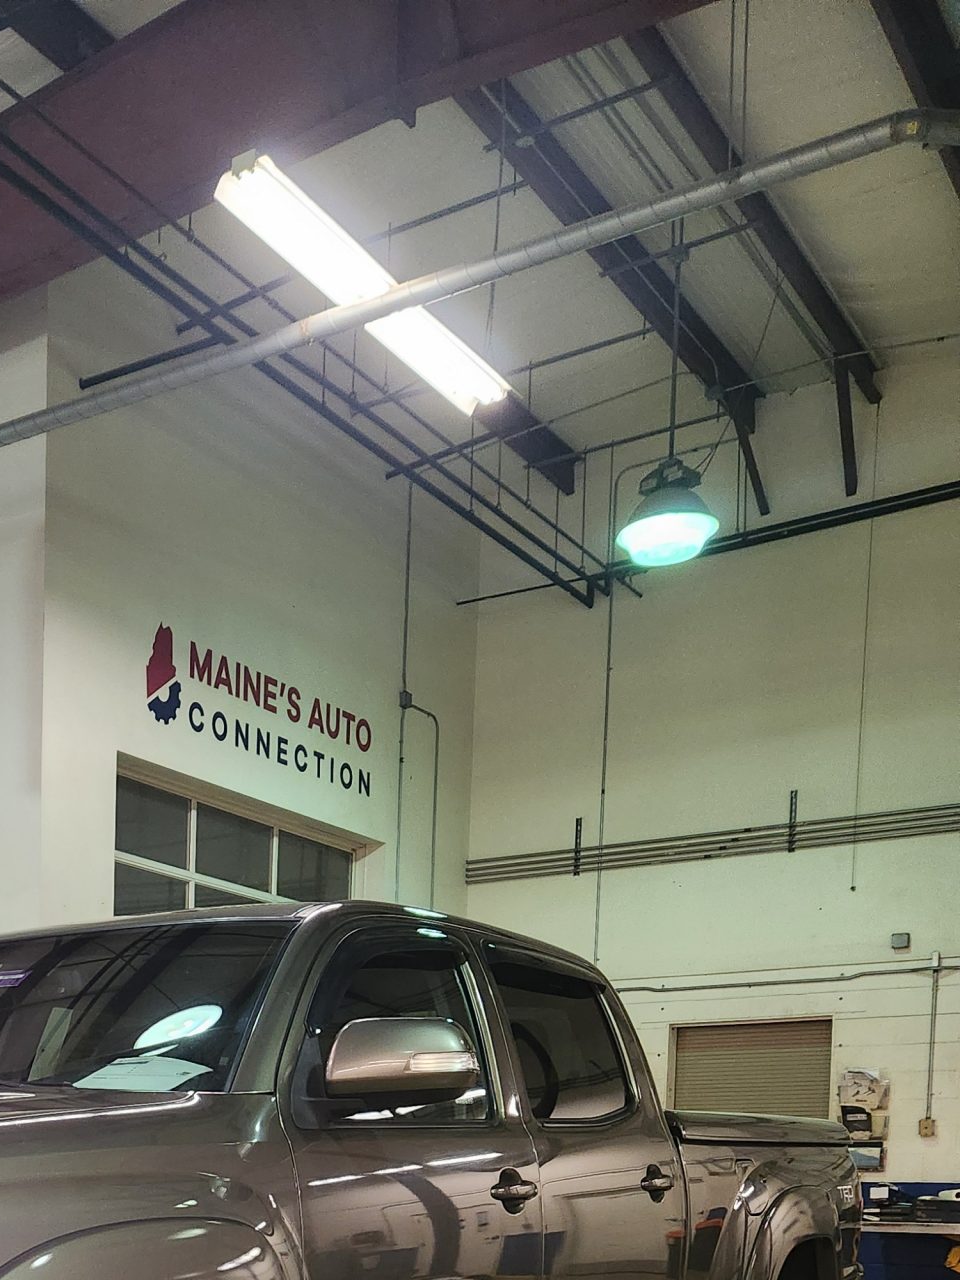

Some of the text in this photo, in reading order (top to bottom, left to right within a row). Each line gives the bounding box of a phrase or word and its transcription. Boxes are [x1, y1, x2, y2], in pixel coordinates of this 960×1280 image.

[189, 640, 372, 752] MAINE'S AUTO
[188, 701, 371, 797] CONNECTION
